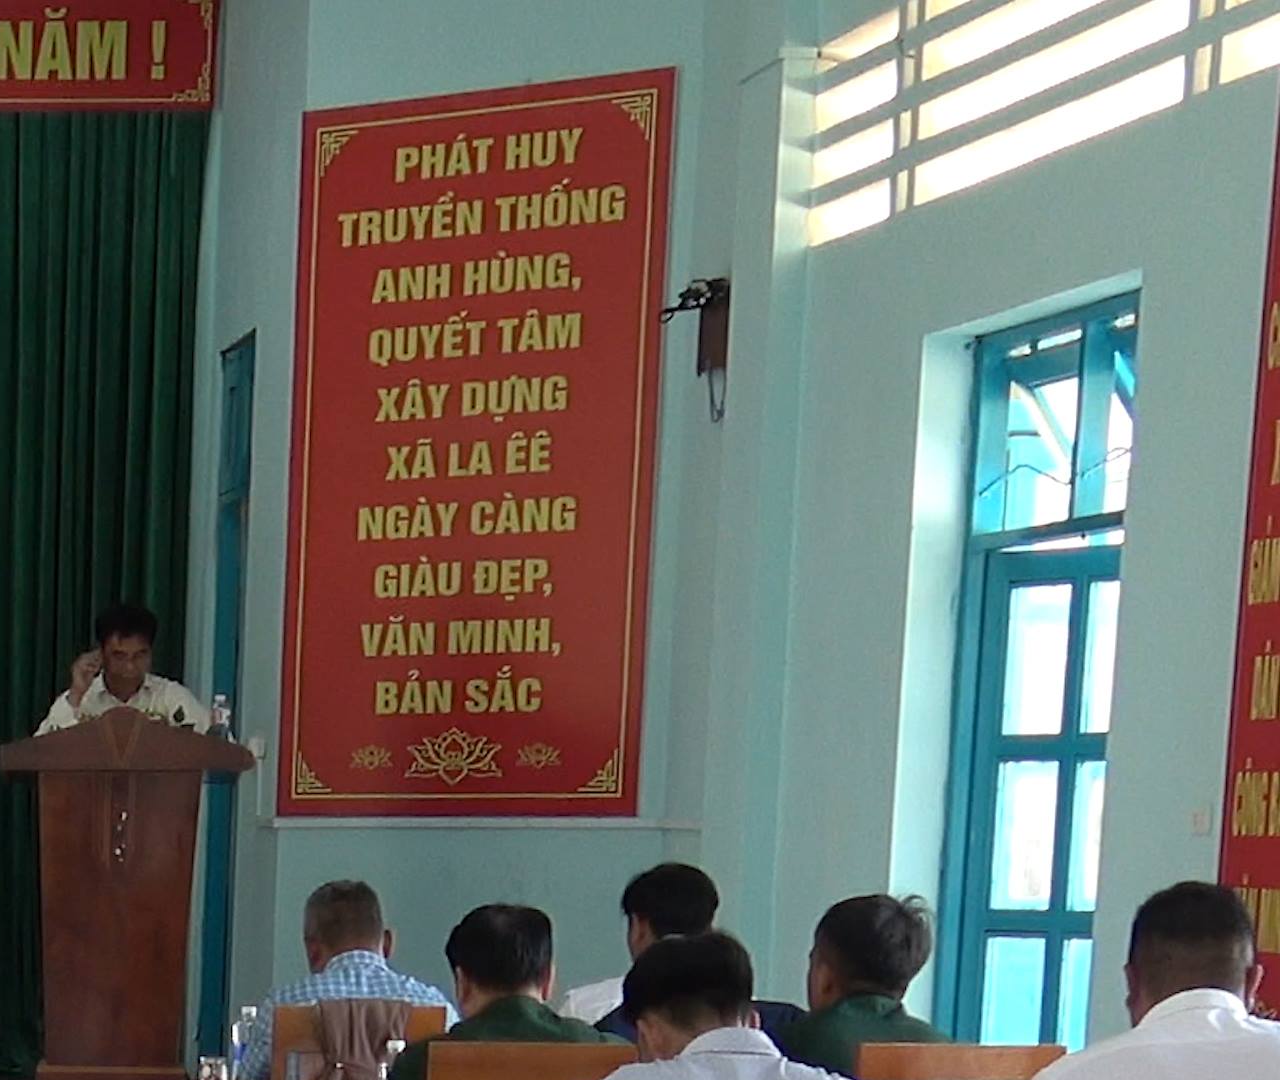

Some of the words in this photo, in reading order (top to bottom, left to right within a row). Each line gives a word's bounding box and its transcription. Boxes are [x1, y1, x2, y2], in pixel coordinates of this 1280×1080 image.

[151, 21, 165, 80] !
[396, 134, 494, 182] PHÁT
[506, 128, 582, 170] HUY
[338, 191, 482, 247] TRUYỀN
[495, 178, 625, 232] THỐNG
[372, 264, 450, 304] ANH
[464, 251, 581, 296] HÙNG,
[369, 311, 486, 366] QUYẾT
[497, 309, 581, 353] TÂM
[375, 379, 449, 422] XÂY
[462, 375, 567, 422] DỰNG
[386, 438, 435, 480] XÃ
[448, 441, 492, 476] LA
[506, 430, 551, 474] ÊÊ
[358, 497, 458, 541] NGÀY
[471, 493, 576, 535] CÀNG
[375, 556, 461, 598] GIÀU
[473, 559, 552, 600] ĐẸP,
[361, 615, 434, 656] VĂN
[448, 618, 560, 656] MINH,
[376, 669, 451, 714] BẢN
[465, 665, 541, 712] SẮC
